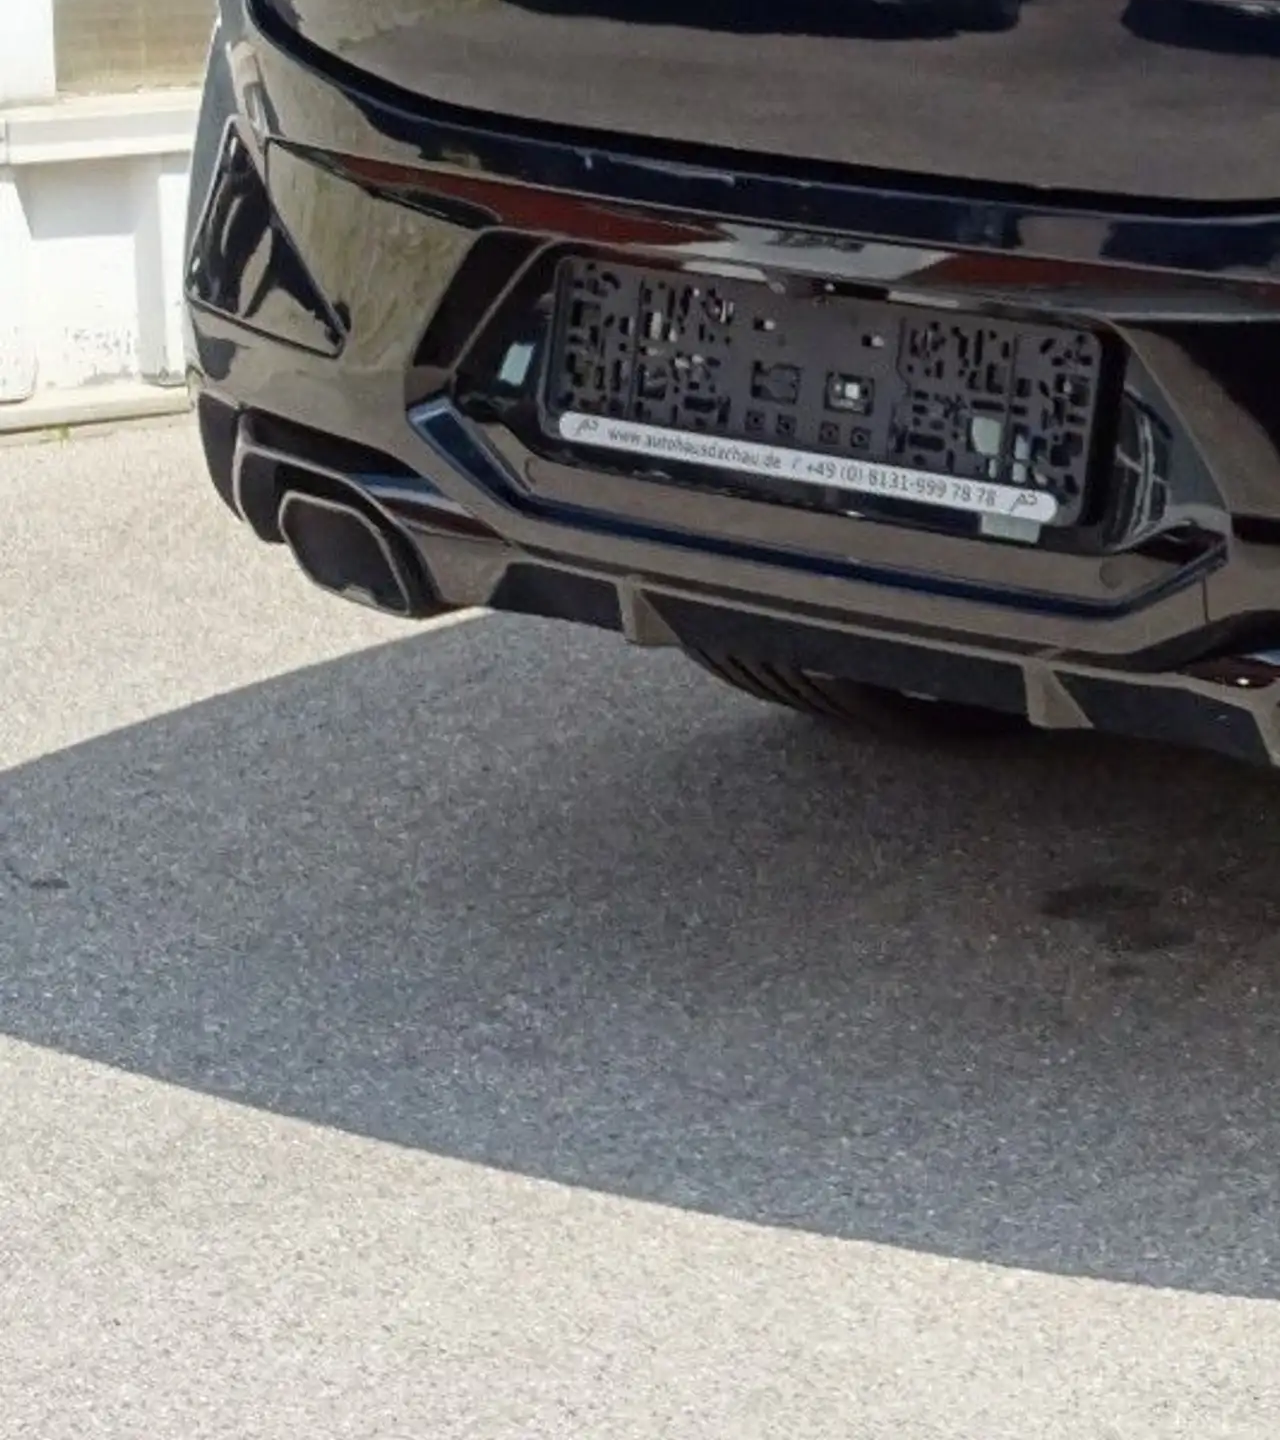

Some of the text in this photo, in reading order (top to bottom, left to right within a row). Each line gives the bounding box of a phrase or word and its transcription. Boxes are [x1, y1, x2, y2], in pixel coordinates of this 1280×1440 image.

[805, 461, 836, 479] +49
[840, 464, 863, 483] (0)
[868, 467, 947, 498] 8131-999
